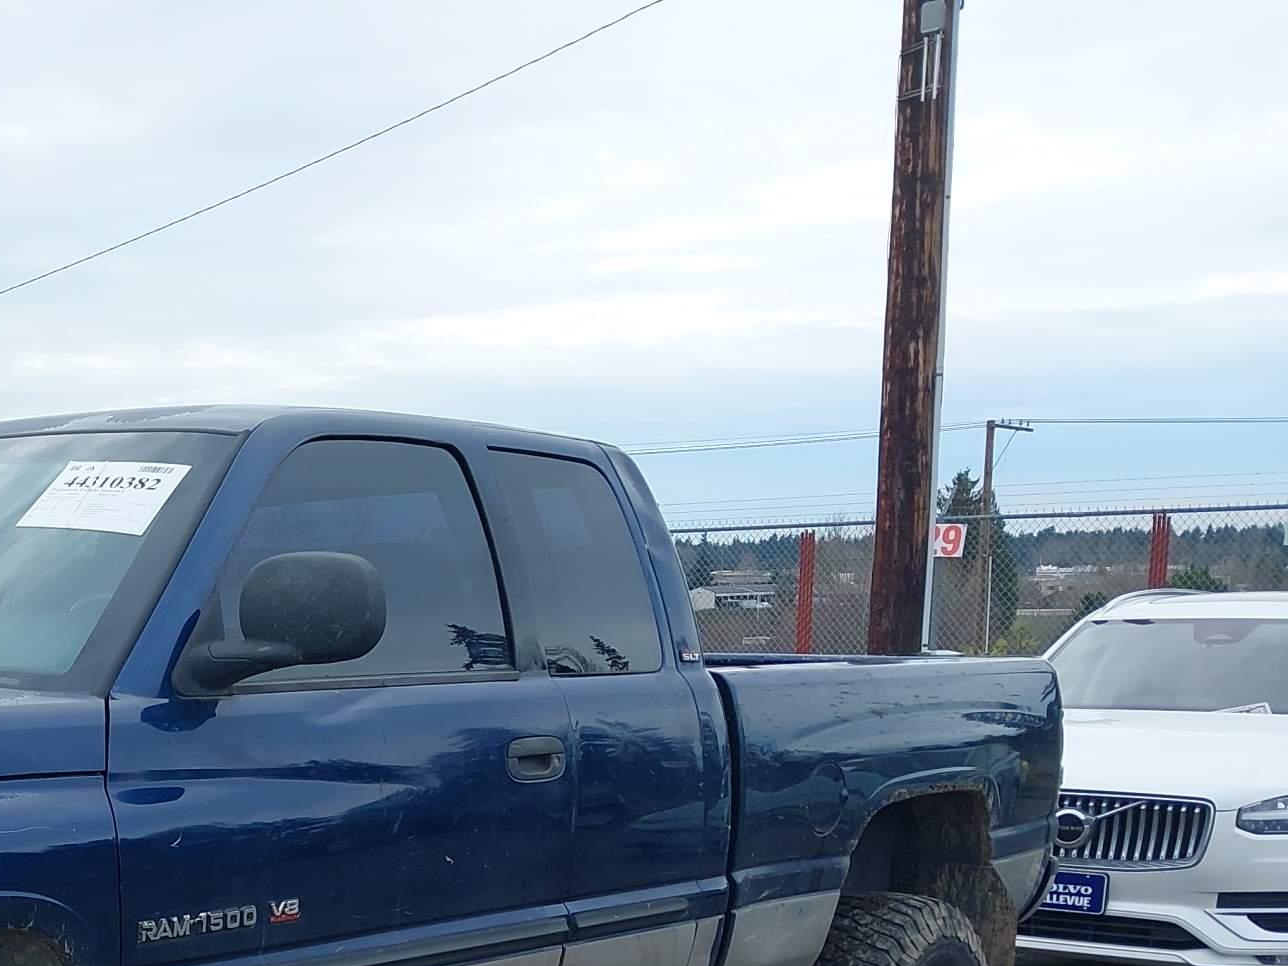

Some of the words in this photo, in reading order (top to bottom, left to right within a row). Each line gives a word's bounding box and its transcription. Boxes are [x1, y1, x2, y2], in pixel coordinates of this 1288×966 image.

[64, 475, 162, 491] 44310382
[934, 525, 962, 556] 9
[682, 653, 700, 661] SLT
[138, 914, 191, 943] RAM
[192, 904, 257, 933] 1500
[269, 898, 300, 917] V8
